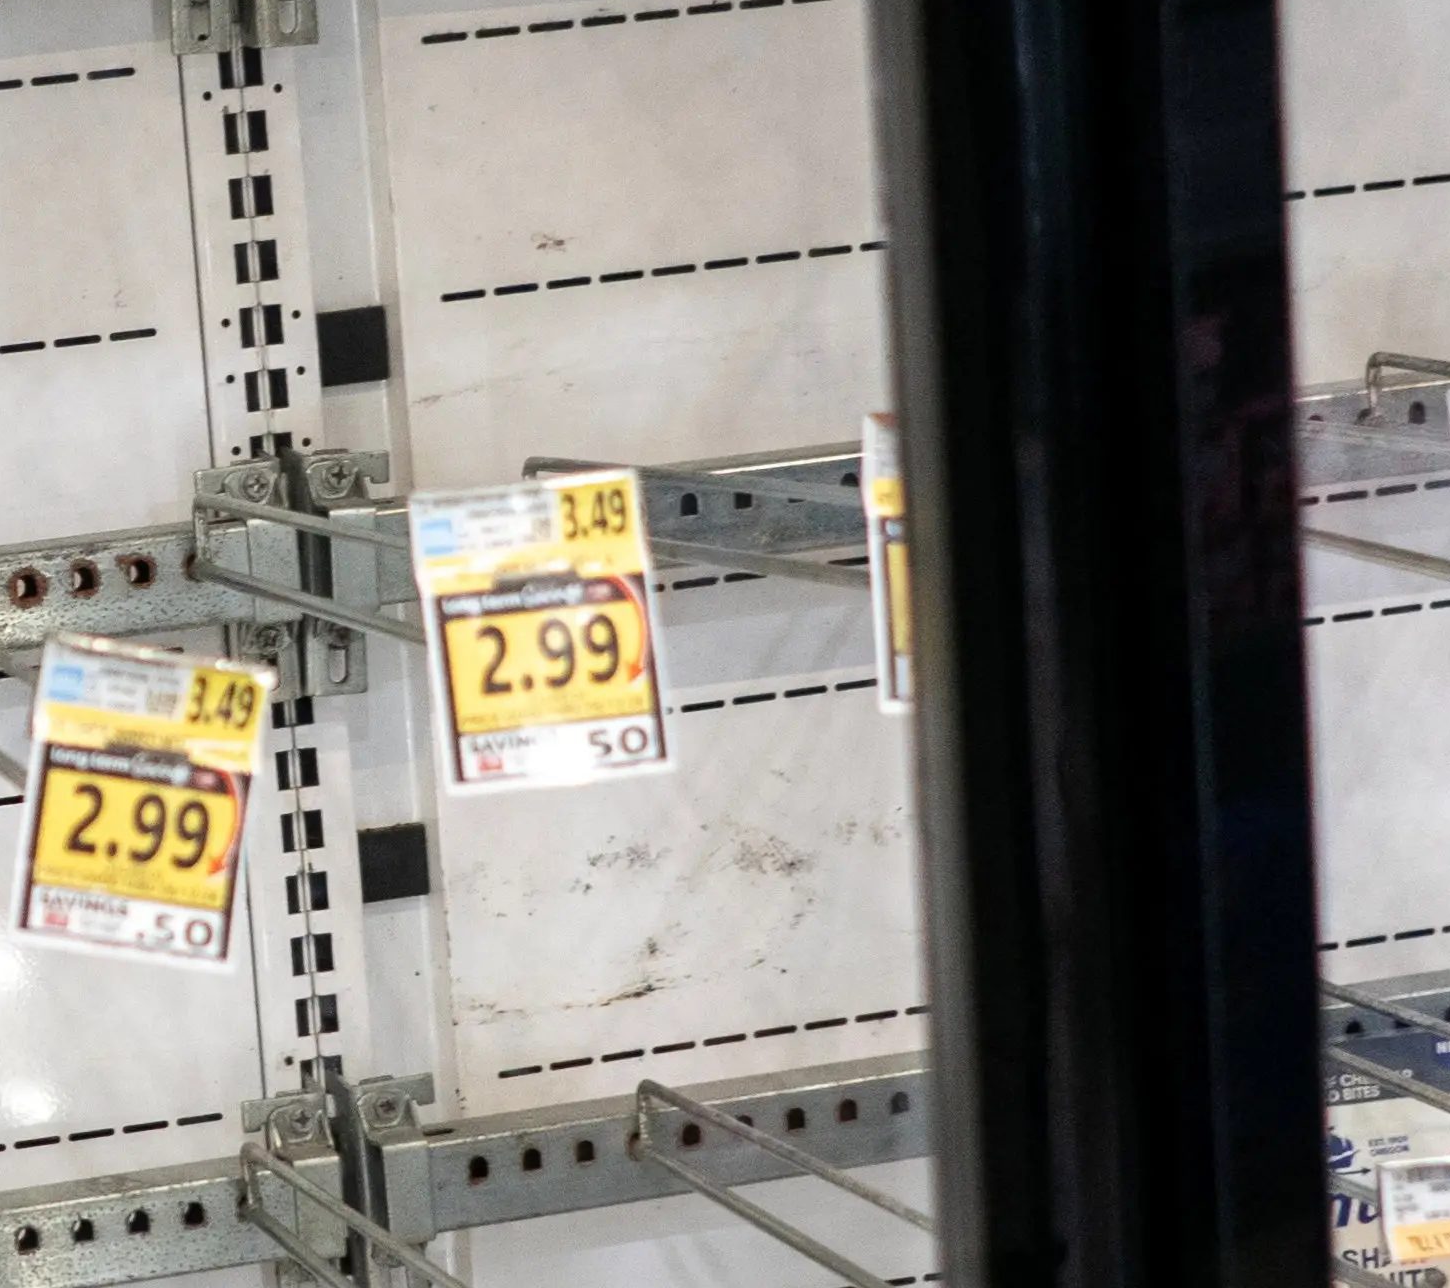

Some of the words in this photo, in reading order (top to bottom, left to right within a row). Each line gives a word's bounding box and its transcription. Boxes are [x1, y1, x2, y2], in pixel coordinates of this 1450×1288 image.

[560, 488, 628, 541] 3.49
[476, 613, 621, 696] 2.99
[187, 676, 256, 731] 3.49
[66, 782, 210, 869] 2.99
[136, 912, 214, 948] .50
